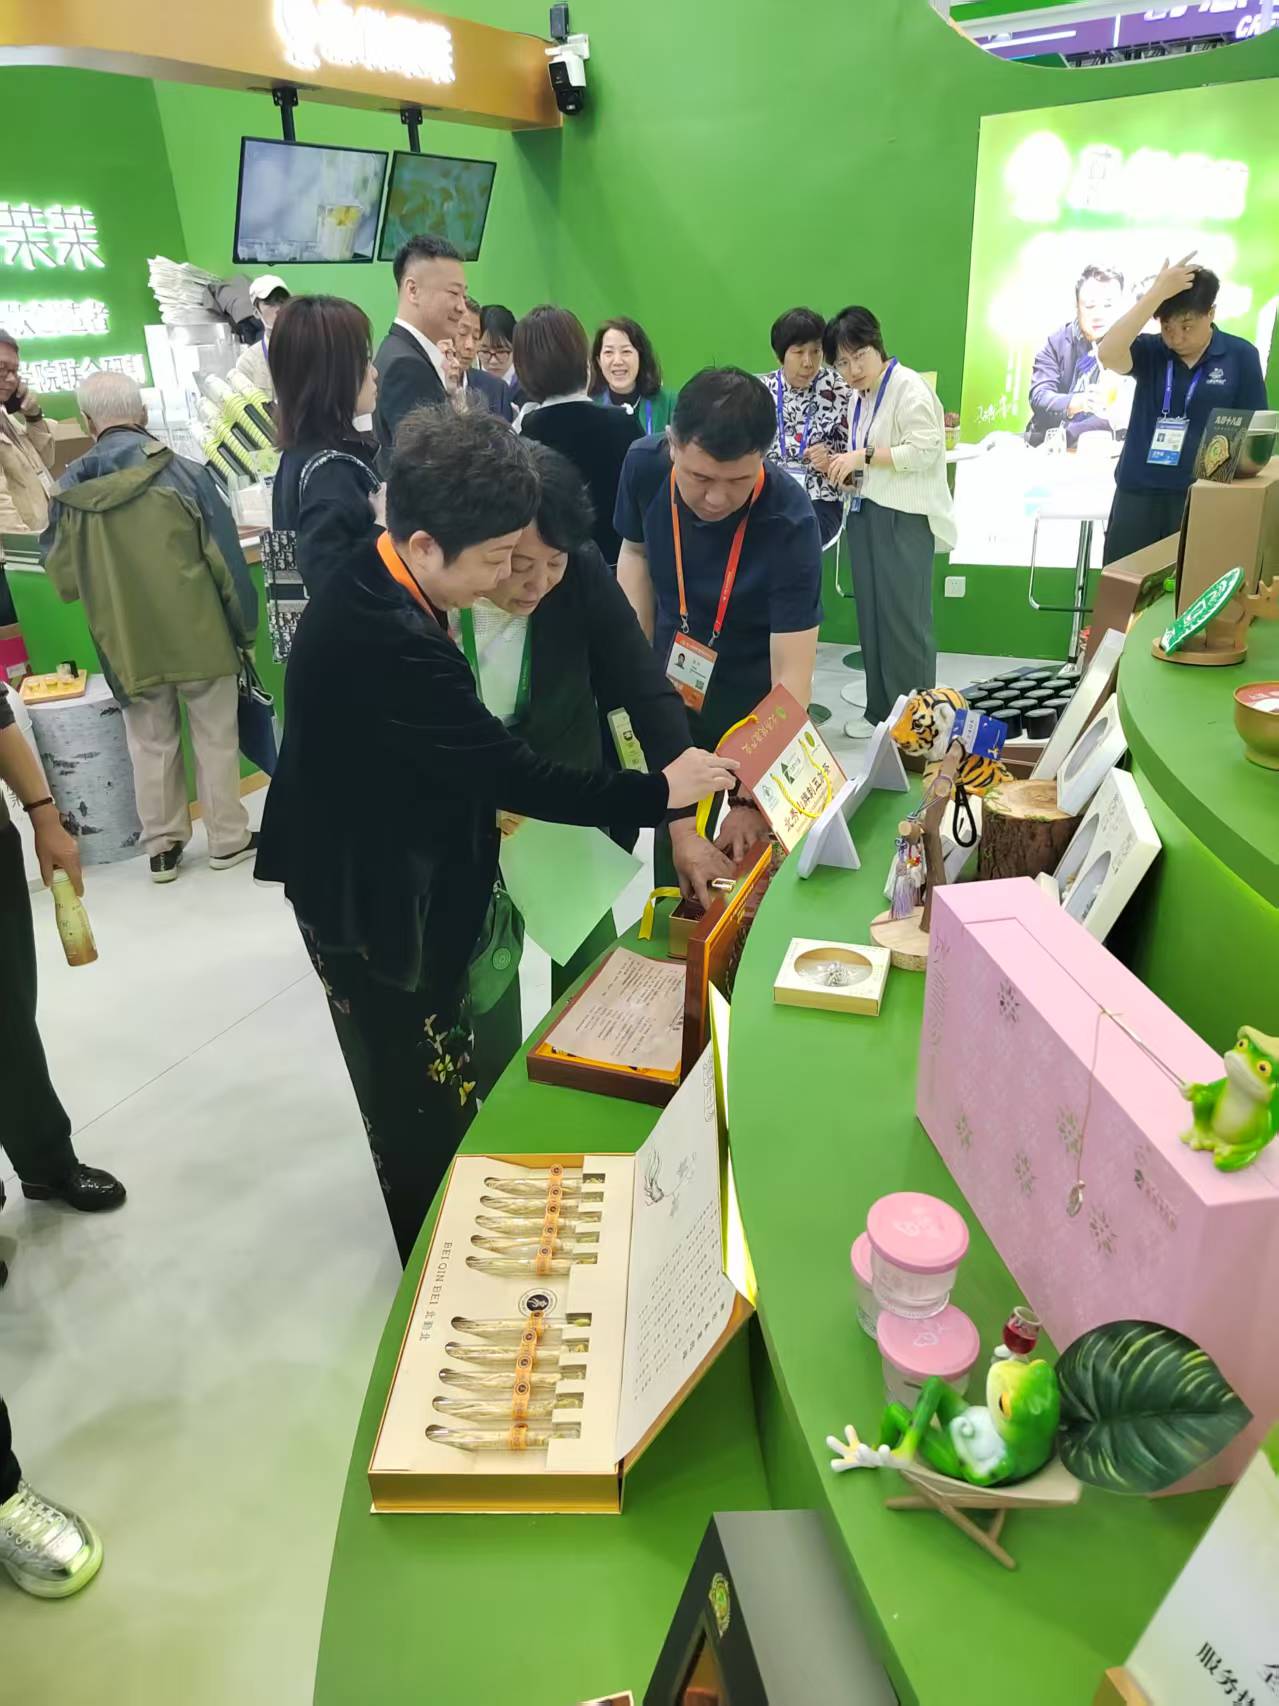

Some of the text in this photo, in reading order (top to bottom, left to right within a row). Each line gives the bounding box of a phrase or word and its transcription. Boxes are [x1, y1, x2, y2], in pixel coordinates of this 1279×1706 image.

[441, 1241, 453, 1259] BEI
[436, 1262, 447, 1282] QIN
[429, 1285, 442, 1304] BEI
